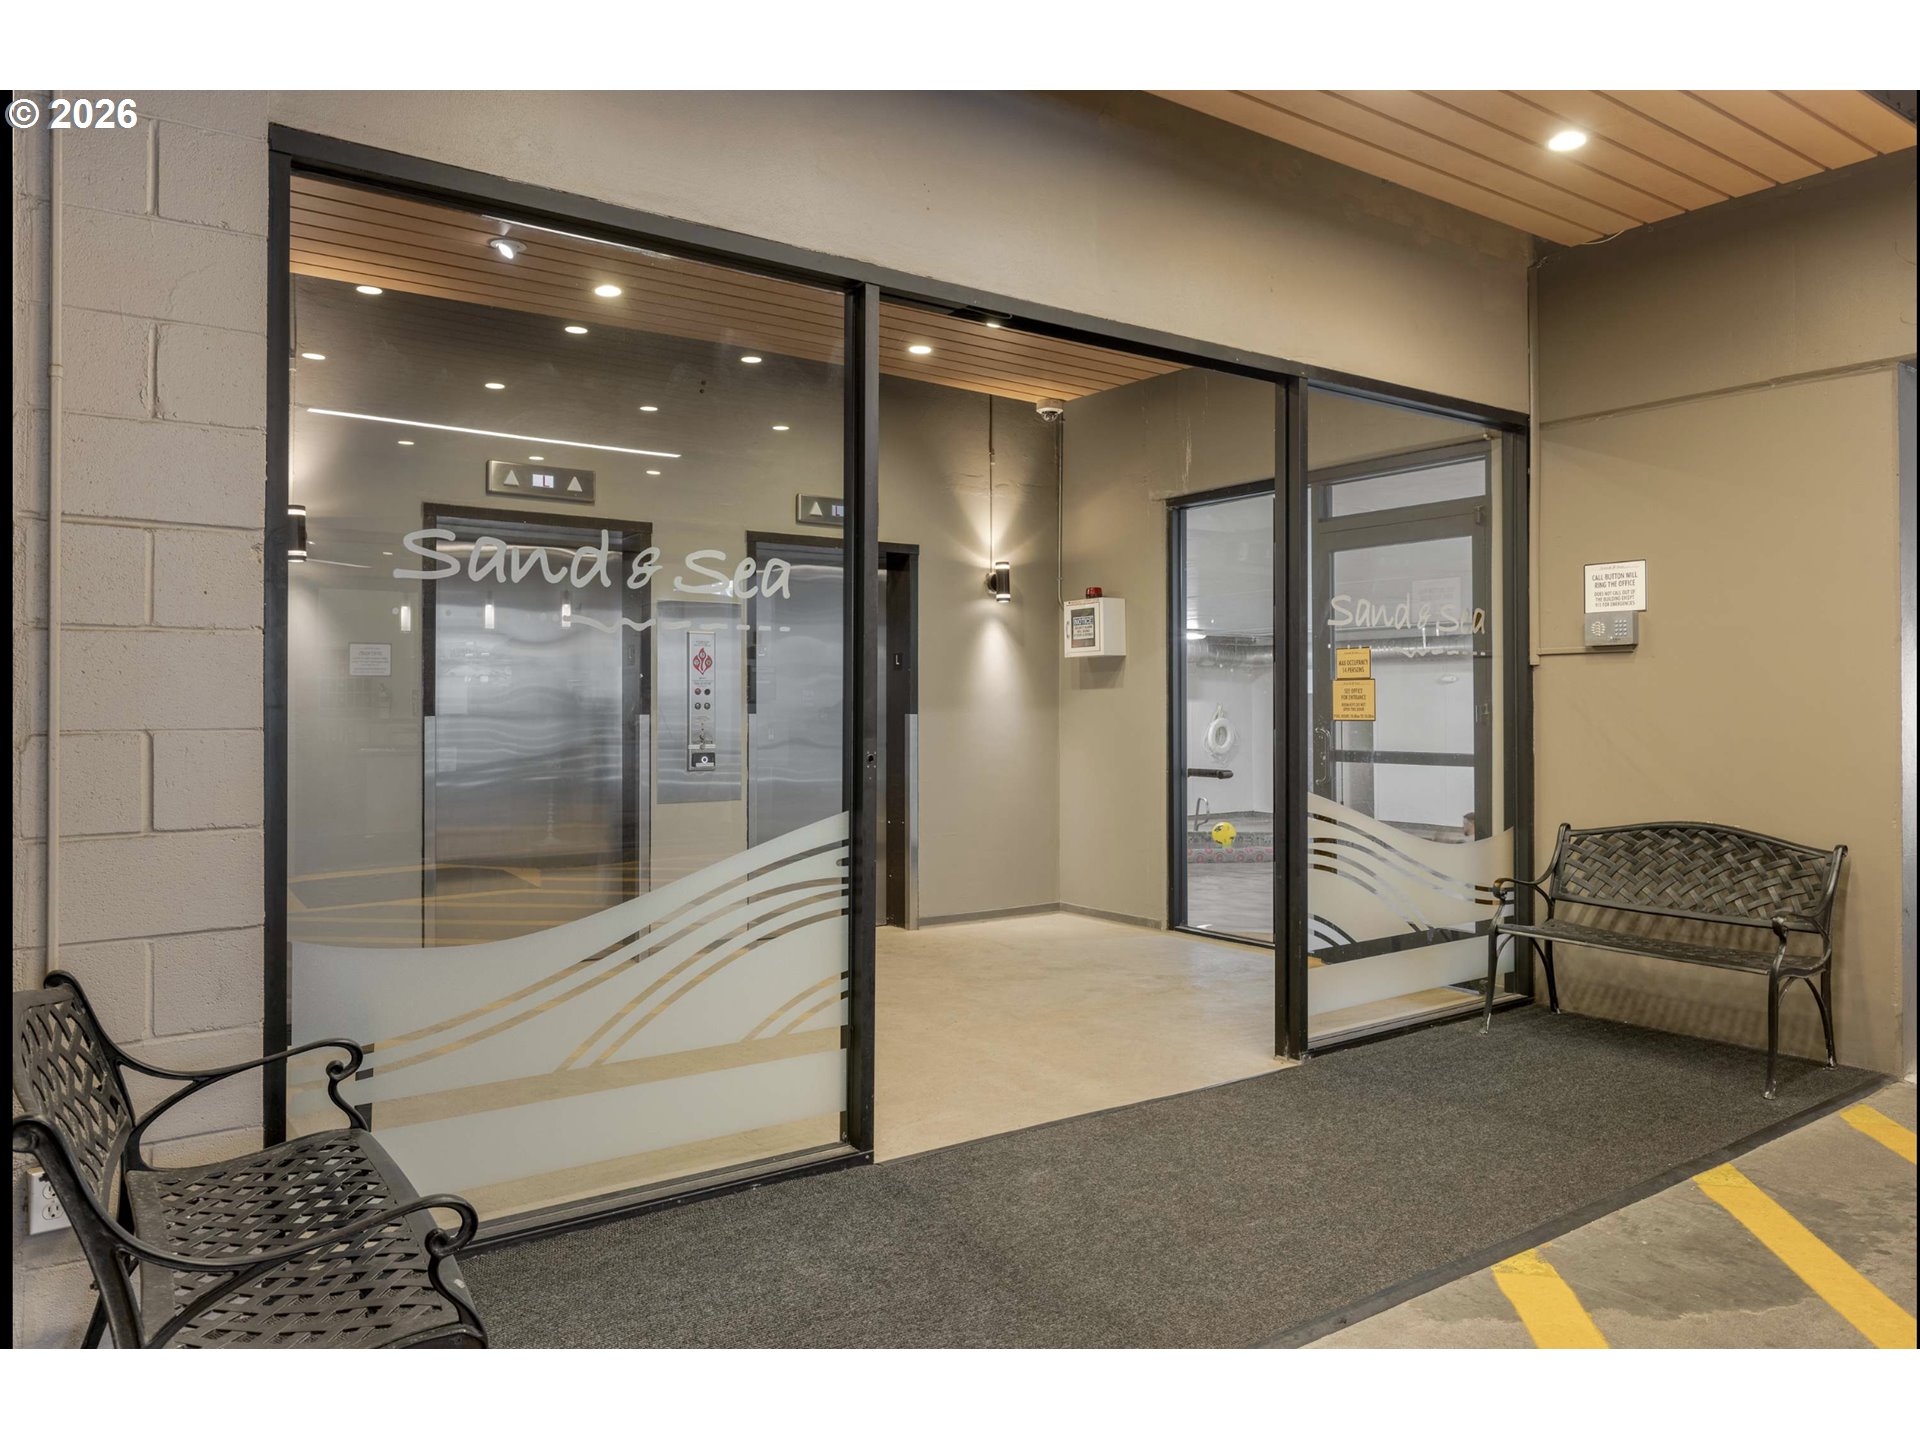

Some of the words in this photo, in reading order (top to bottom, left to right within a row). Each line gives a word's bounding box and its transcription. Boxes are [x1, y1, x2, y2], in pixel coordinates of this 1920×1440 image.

[393, 529, 611, 589] Sand
[627, 546, 662, 590] &
[673, 549, 791, 600] Sea
[1327, 593, 1411, 629] Sand
[1416, 603, 1431, 628] &
[1437, 604, 1486, 635] Sea
[895, 654, 900, 665] L
